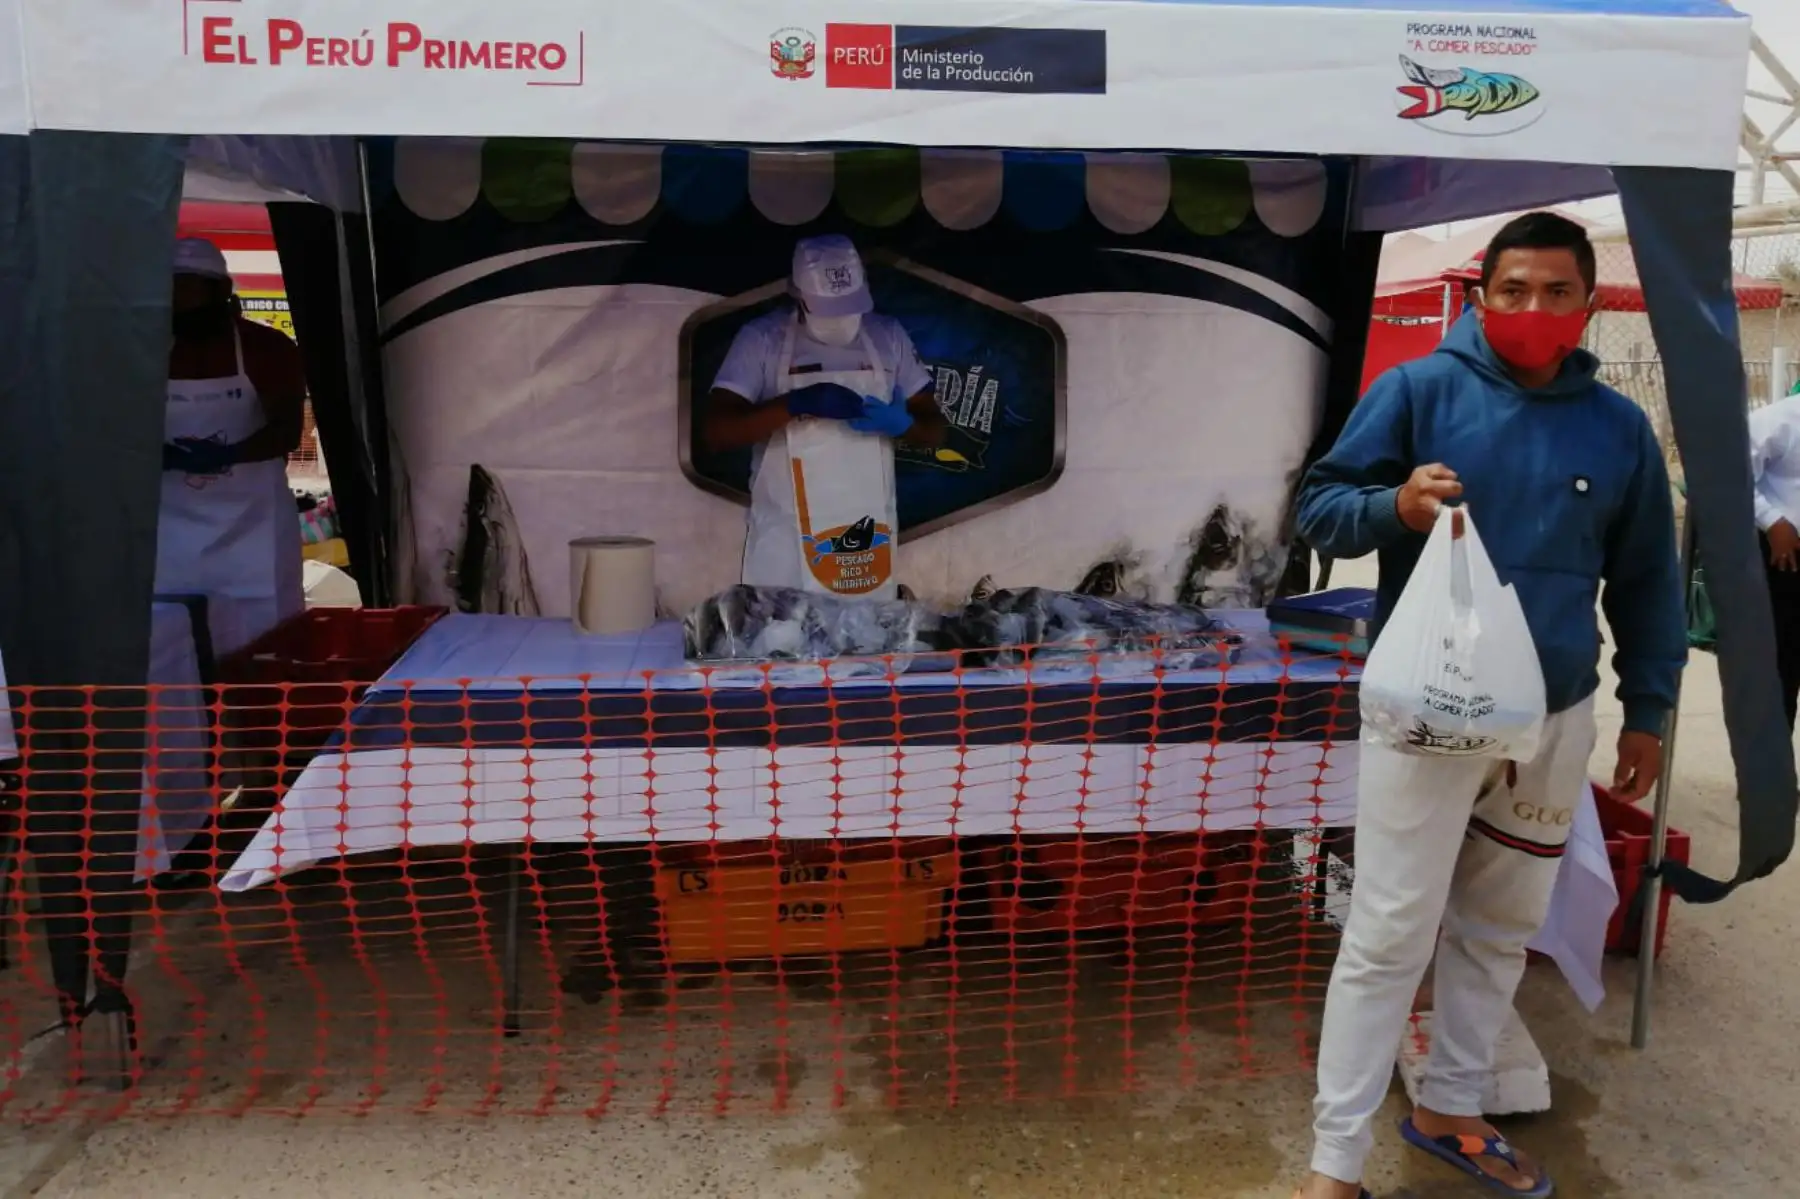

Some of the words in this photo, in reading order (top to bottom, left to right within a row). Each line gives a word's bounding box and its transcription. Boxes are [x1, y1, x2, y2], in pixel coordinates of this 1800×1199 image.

[1406, 23, 1472, 36] PROGRAMA
[1477, 25, 1537, 39] NACIONAL
[267, 18, 374, 67] PERÚ
[387, 22, 567, 70] PRIMERO
[1427, 39, 1470, 53] COMER
[1474, 41, 1537, 55] PESCADO"
[833, 43, 885, 65] PERÚ
[902, 48, 984, 65] Ministerio
[902, 65, 922, 80] de
[926, 66, 941, 80] la
[946, 66, 1034, 83] Producción
